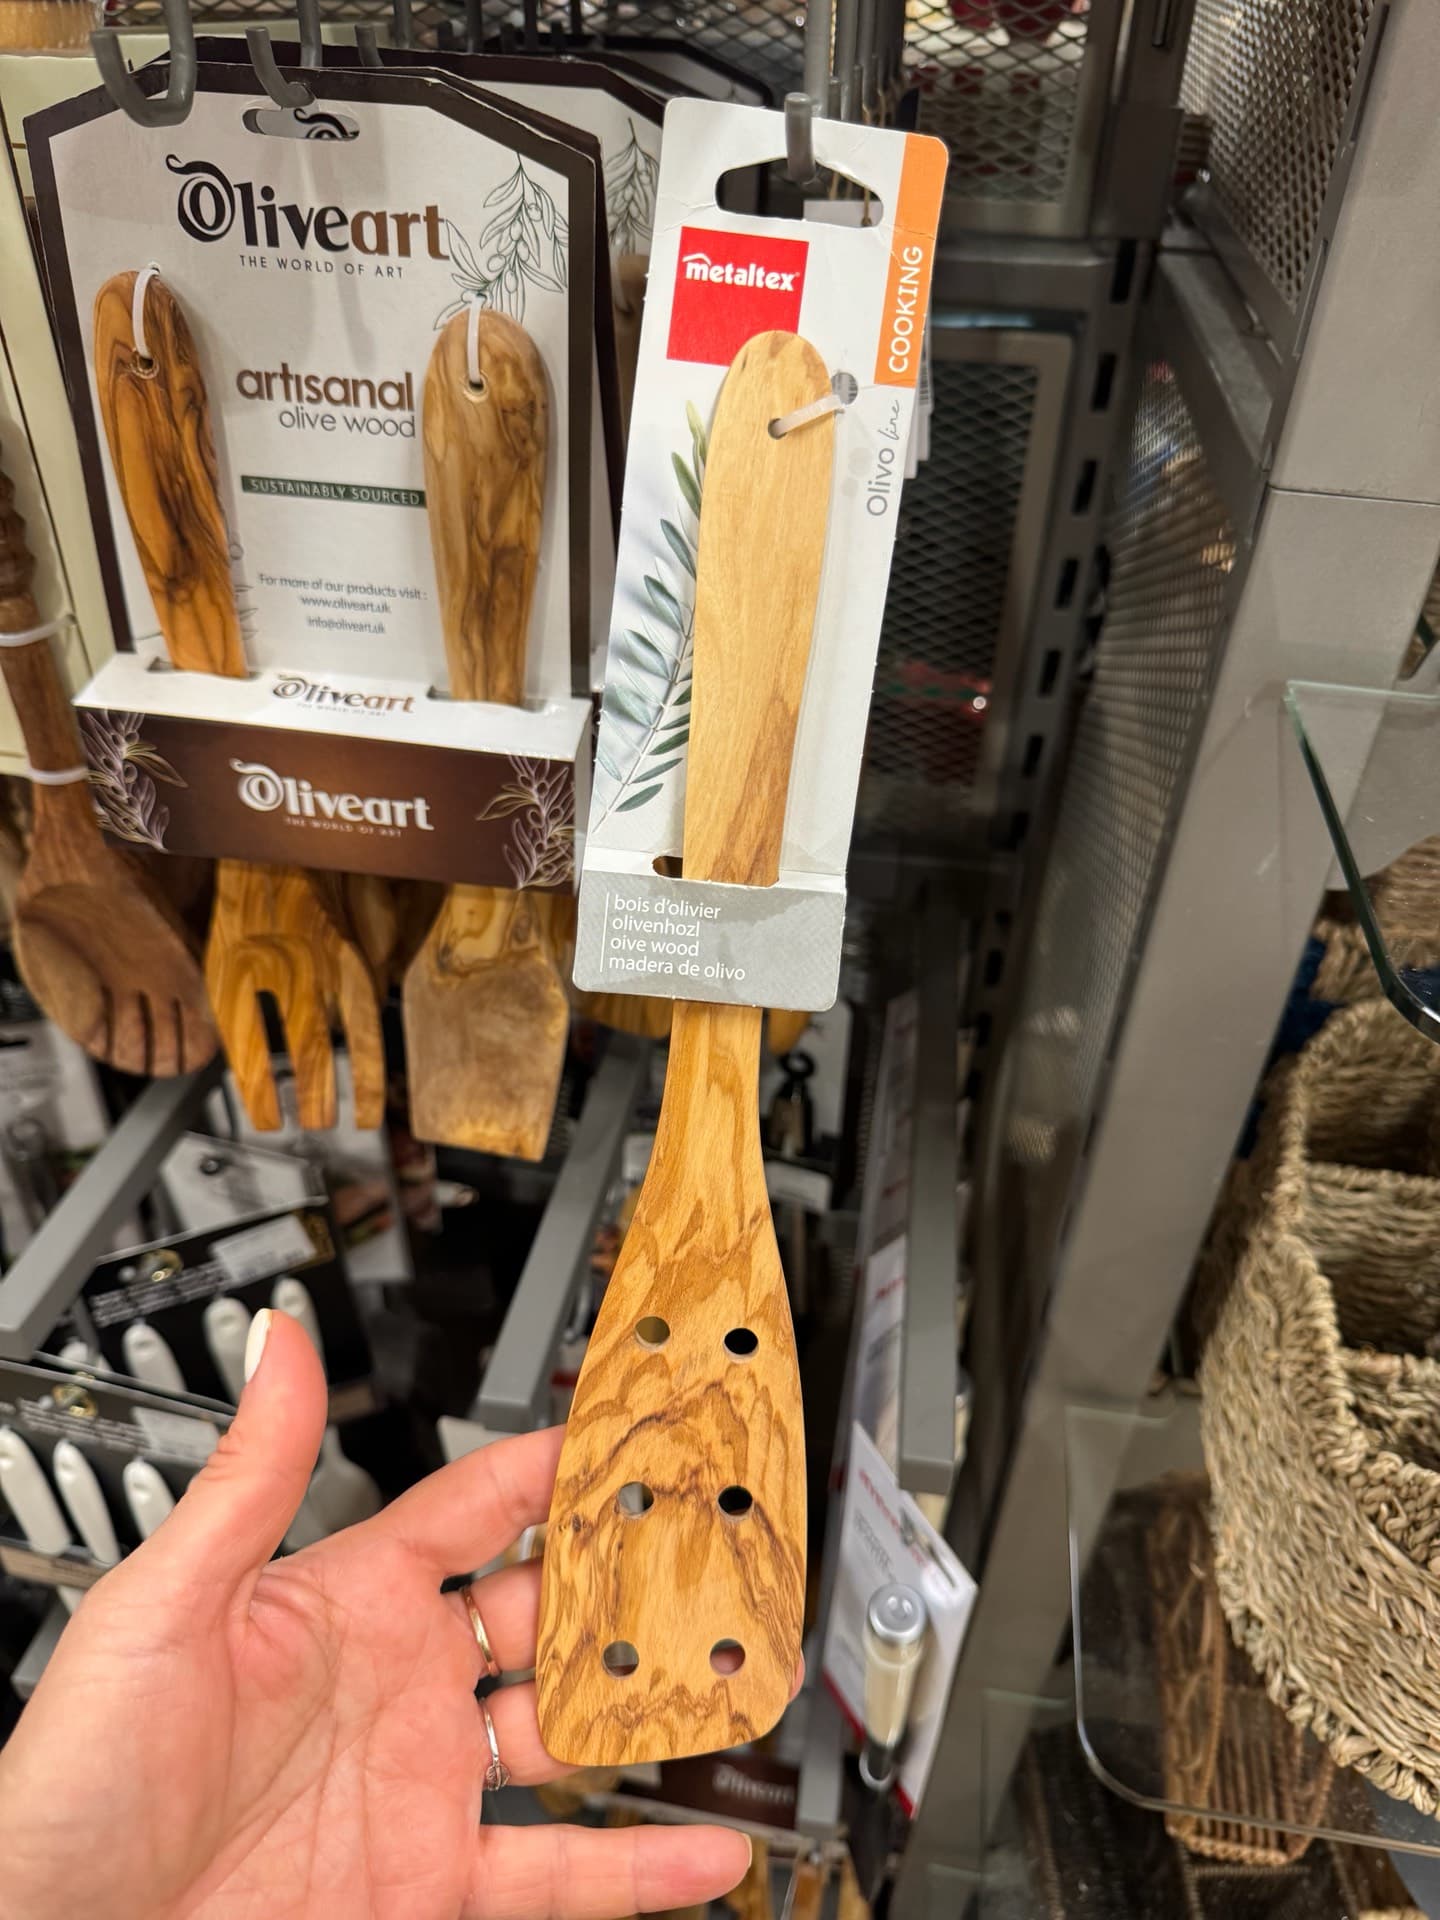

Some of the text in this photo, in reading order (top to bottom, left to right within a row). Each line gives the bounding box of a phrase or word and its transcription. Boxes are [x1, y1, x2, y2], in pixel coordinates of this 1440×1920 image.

[165, 153, 450, 260] Oliveart
[239, 255, 404, 279] THE WORLD OF ART
[682, 253, 796, 291] metaltex
[888, 246, 923, 374] COOKING
[236, 362, 415, 412] artisanal
[279, 406, 416, 438] olive wood
[250, 479, 420, 505] SUSTAINABLY SOURCED
[866, 448, 896, 516] Olivo
[259, 573, 277, 585] For
[280, 577, 308, 589] more
[311, 578, 322, 590] of
[325, 582, 344, 593] our
[347, 583, 397, 598] products
[272, 674, 416, 713] Oliveart
[230, 758, 434, 831] Oliveart
[614, 895, 650, 914] bois
[612, 916, 701, 937] olivenhozl
[610, 935, 699, 957] oive wood
[608, 956, 746, 981] madera de olivo
